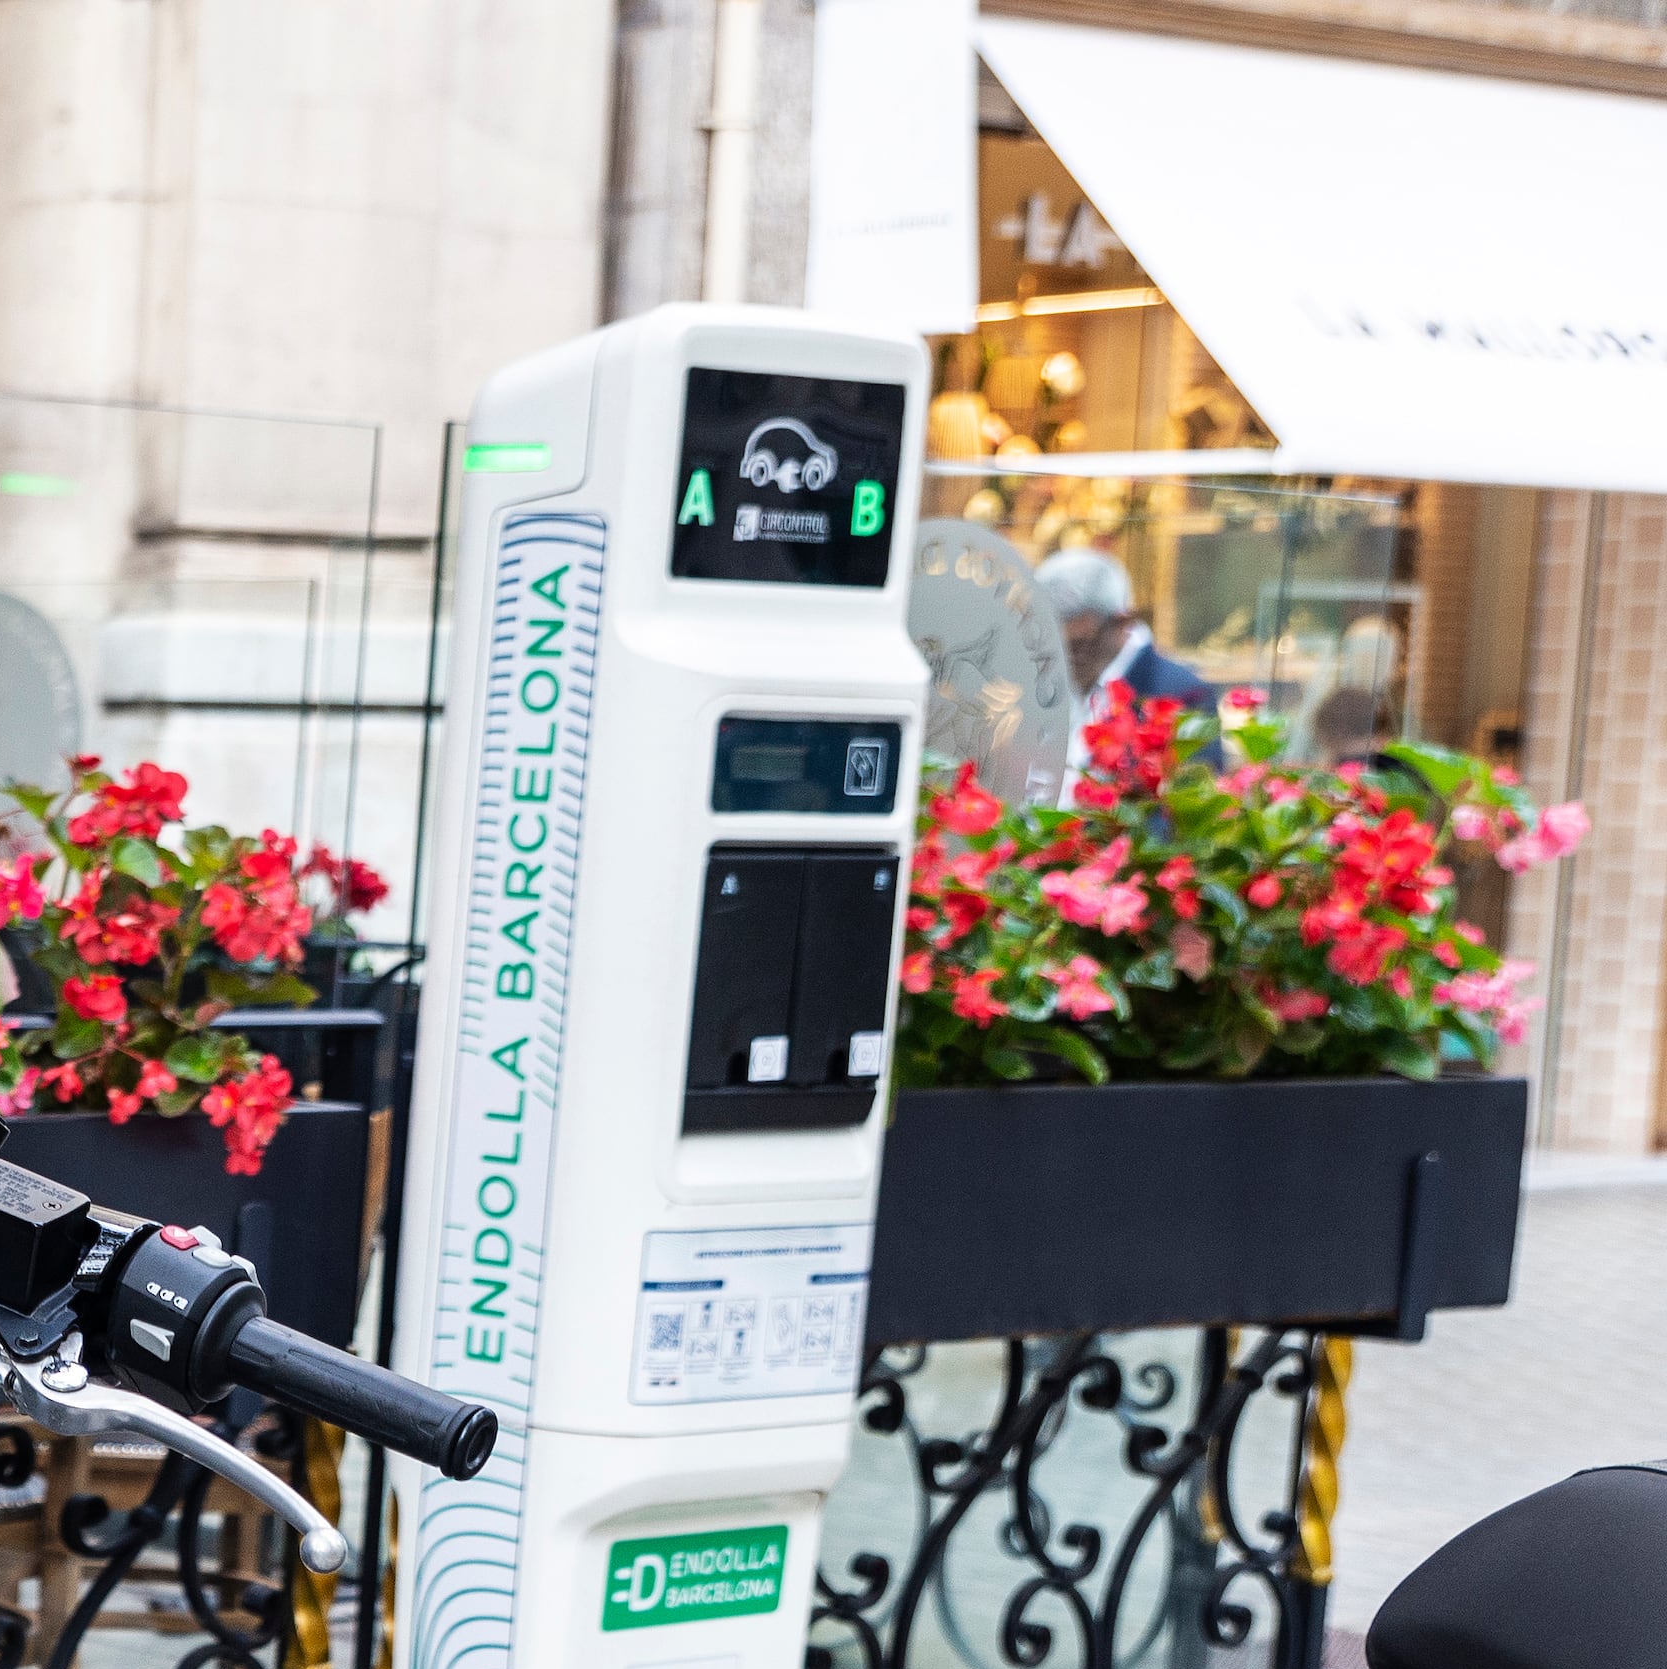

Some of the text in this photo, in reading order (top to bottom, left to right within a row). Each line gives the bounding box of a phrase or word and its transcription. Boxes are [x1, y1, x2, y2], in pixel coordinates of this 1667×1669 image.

[678, 468, 715, 527] A
[851, 480, 887, 536] B
[496, 563, 571, 1001] BARCELONA
[465, 1036, 530, 1365] ENDOLLA
[669, 1544, 780, 1578] ENDOLLA
[665, 1578, 776, 1609] BARCELONA
